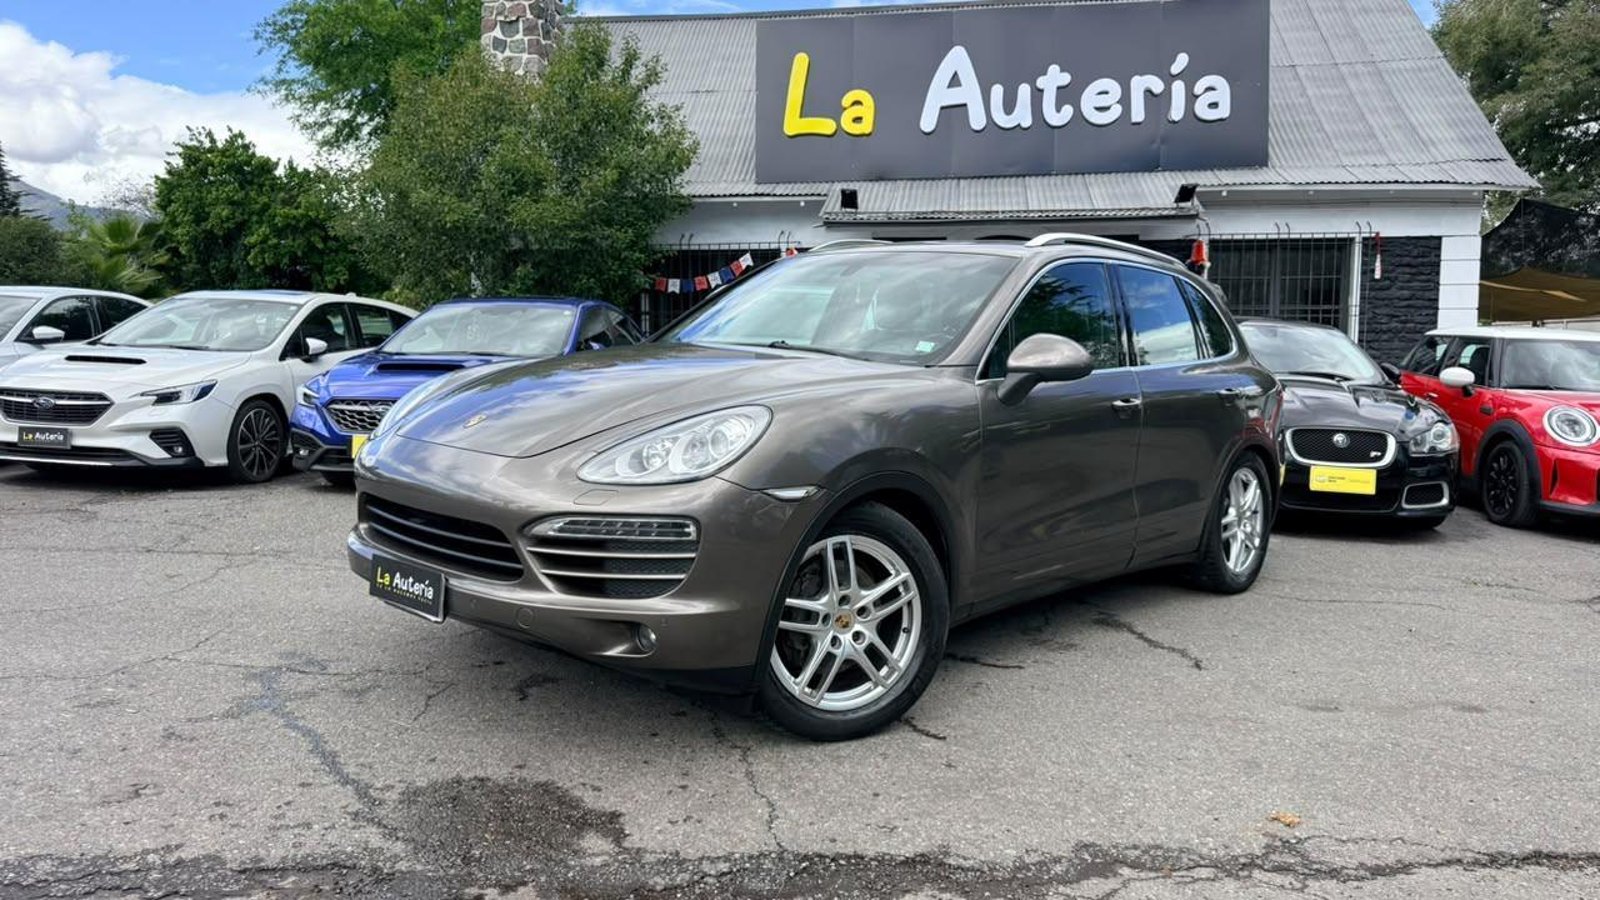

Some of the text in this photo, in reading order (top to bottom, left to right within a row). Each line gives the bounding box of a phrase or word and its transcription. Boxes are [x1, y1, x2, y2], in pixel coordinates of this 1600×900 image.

[782, 44, 1231, 137] La Autería
[377, 566, 391, 585] La
[393, 571, 434, 600] Autería
